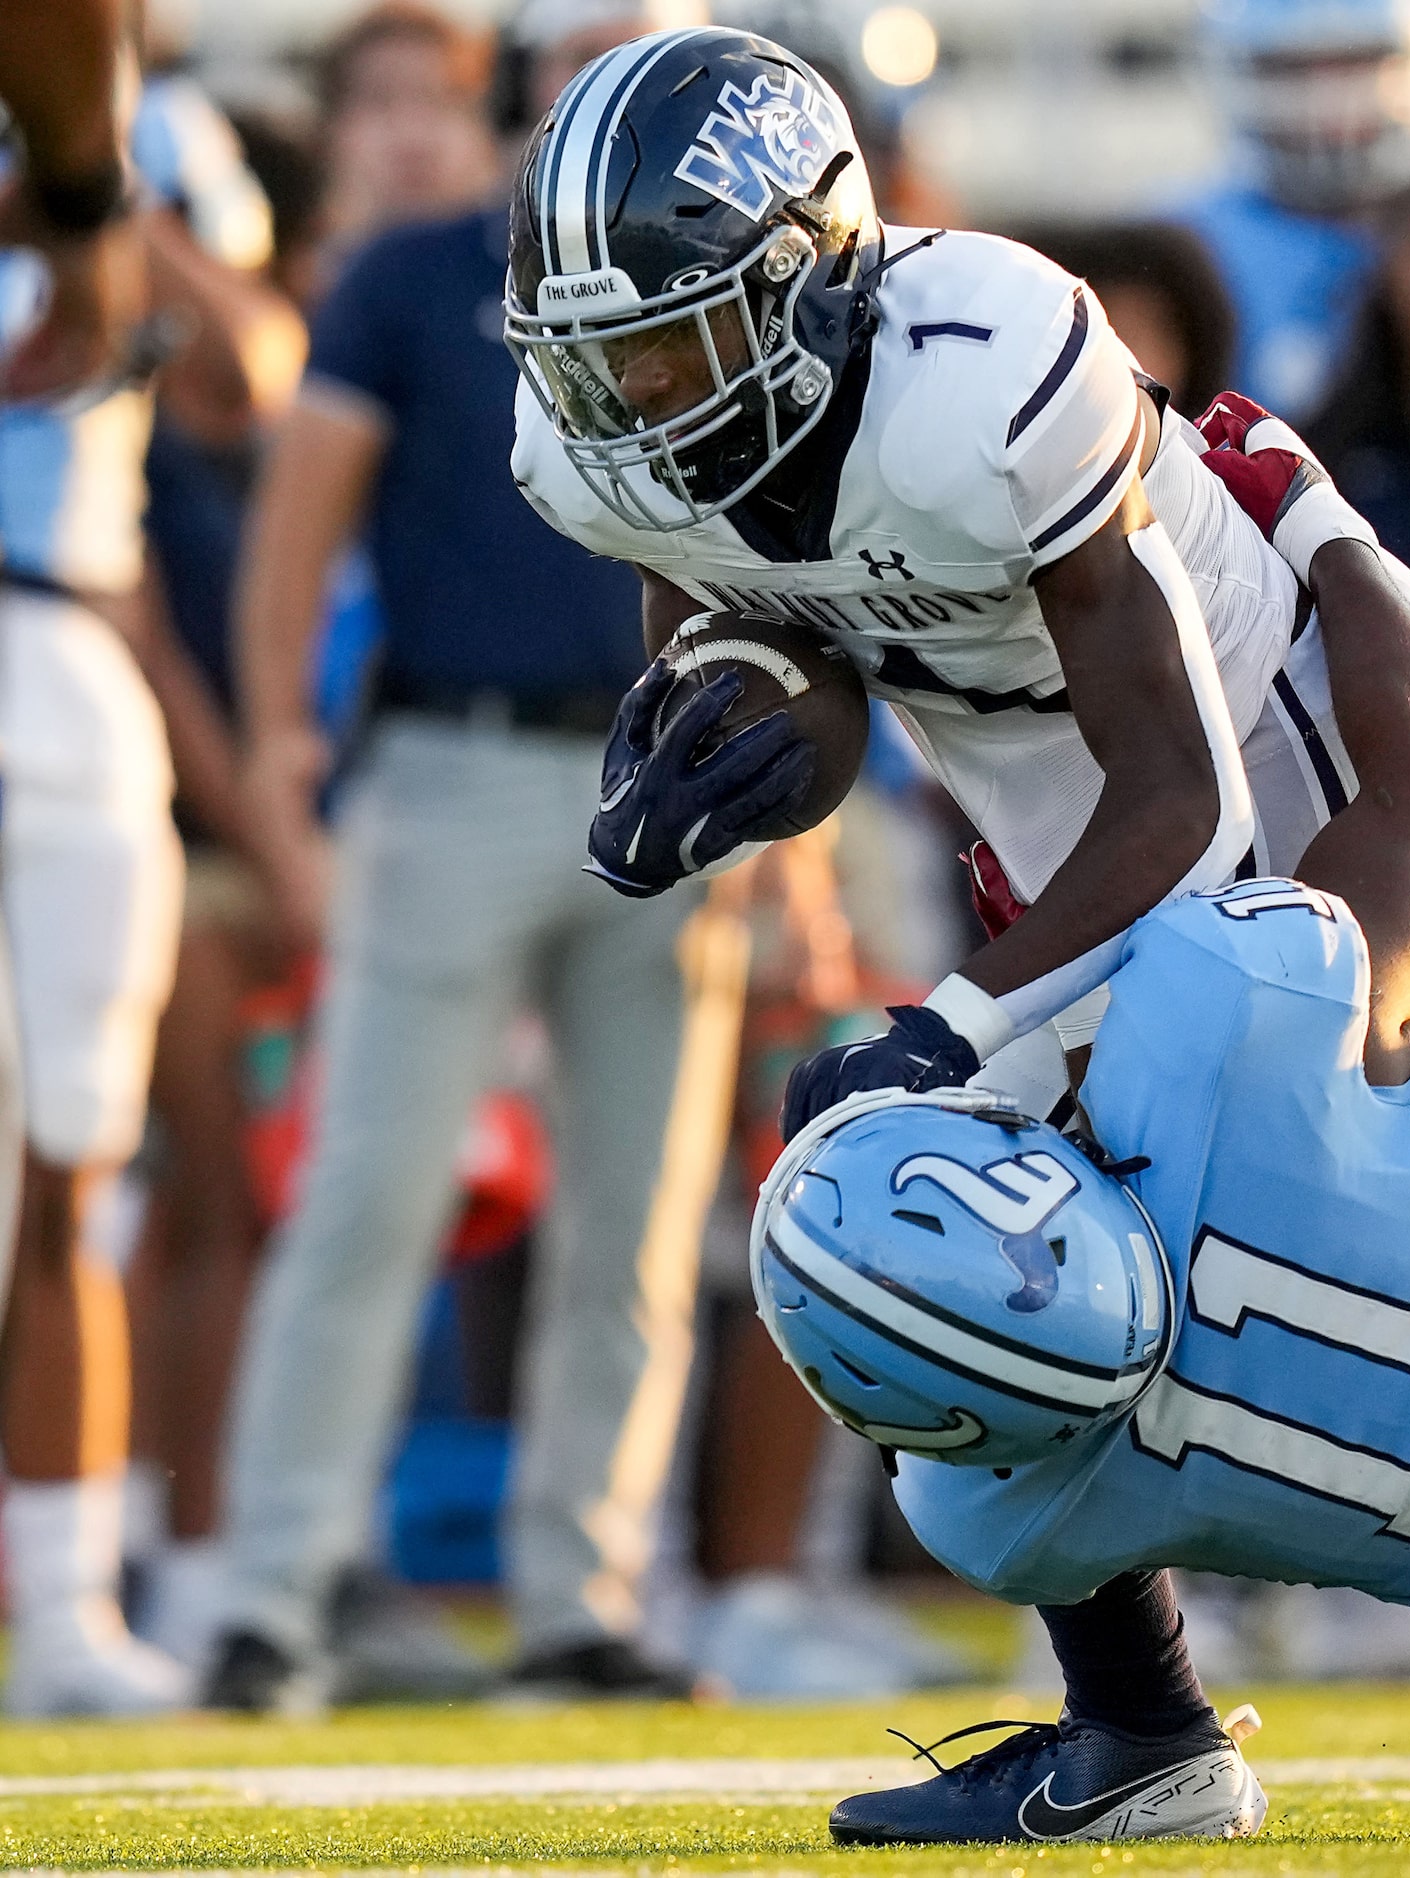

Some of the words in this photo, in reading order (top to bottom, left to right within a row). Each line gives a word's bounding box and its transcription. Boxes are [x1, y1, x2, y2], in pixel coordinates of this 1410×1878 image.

[545, 285, 568, 301] THE
[570, 276, 617, 299] GROVE
[904, 319, 1000, 356] 1
